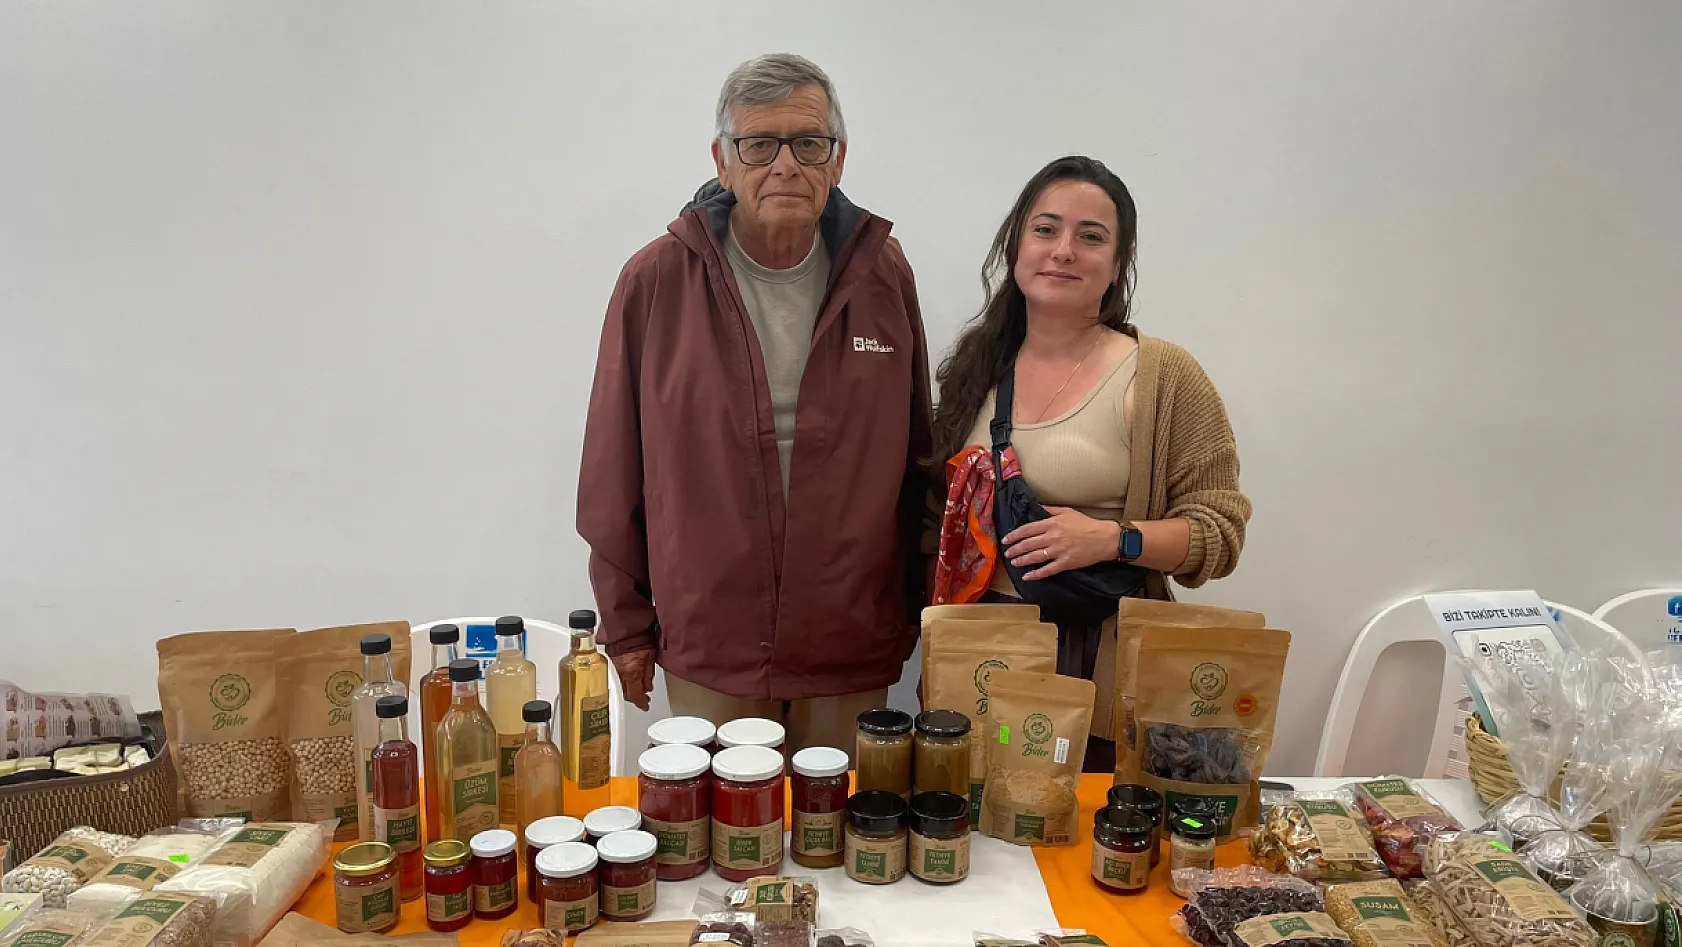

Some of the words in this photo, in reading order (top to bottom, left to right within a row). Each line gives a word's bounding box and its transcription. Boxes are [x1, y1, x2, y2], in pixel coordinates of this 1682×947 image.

[1464, 607, 1508, 621] TAKİPTE
[1190, 700, 1221, 717] Bider
[212, 711, 248, 731] Bider
[1021, 742, 1050, 757] Bider
[1359, 901, 1400, 911] SUSAM
